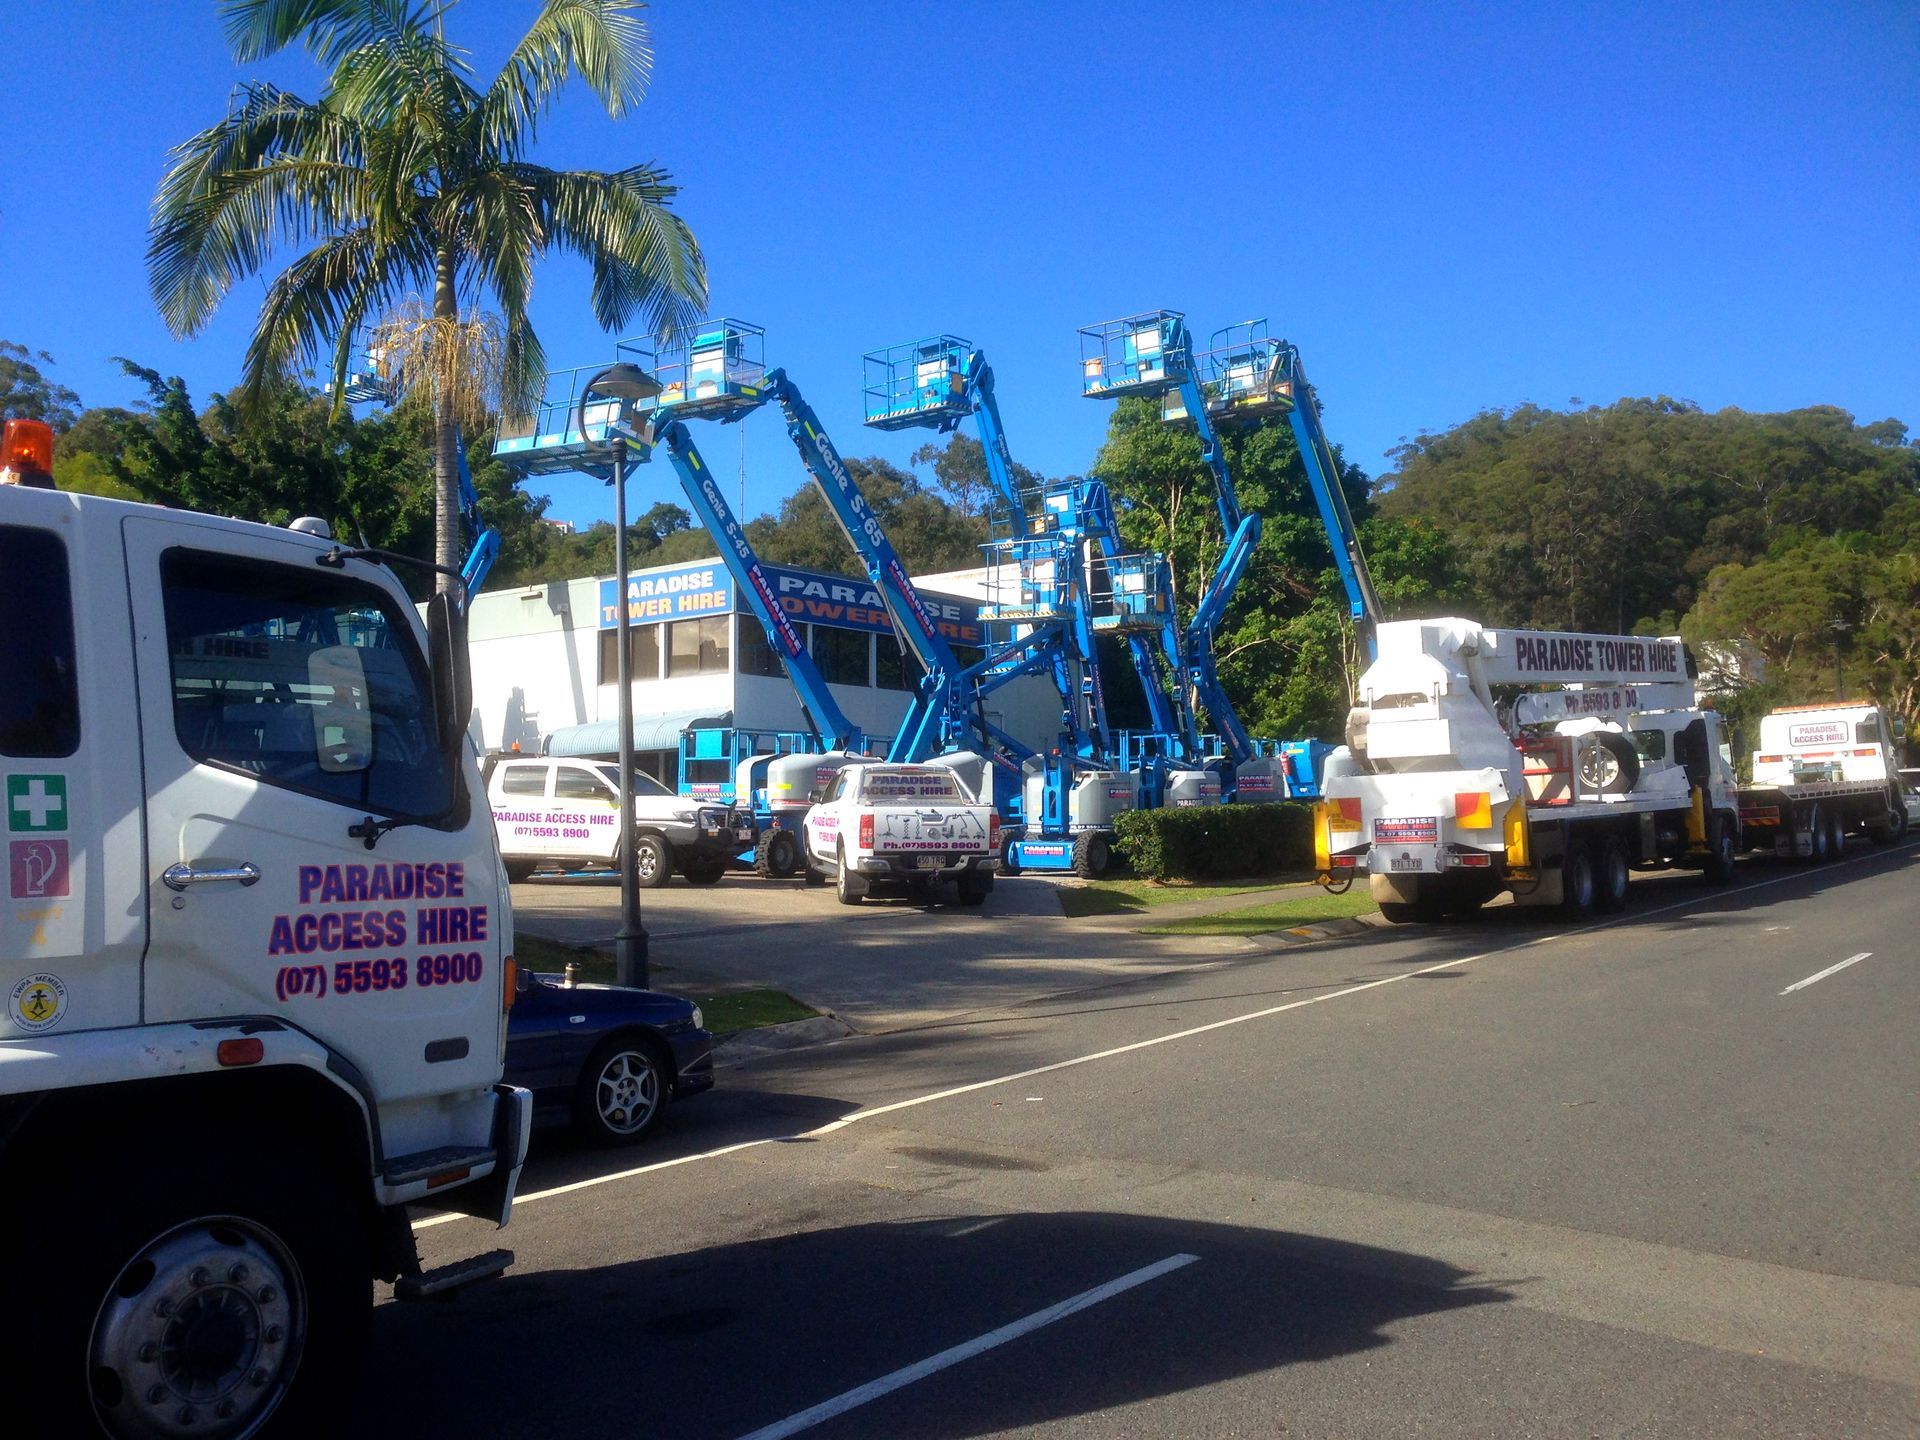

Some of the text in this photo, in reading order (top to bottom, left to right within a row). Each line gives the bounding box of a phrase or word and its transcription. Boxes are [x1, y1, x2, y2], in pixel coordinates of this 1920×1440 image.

[816, 432, 885, 547] Genie S-65
[703, 479, 750, 559] Genie S-45
[1108, 520, 1120, 549] Genie
[628, 570, 714, 599] ARADISE
[678, 590, 726, 612] HIRE
[752, 564, 802, 652] PARADISE
[779, 596, 893, 627] OWER
[1515, 637, 1678, 673] PARADISE TOWER HIRE
[1794, 732, 1845, 744] ACCESS HIRE
[1800, 725, 1838, 735] PARADISE
[864, 786, 953, 796] ACCESS HIRE
[872, 776, 941, 785] PARADISE
[492, 811, 615, 826] PARADISE ACCESS HIRE
[1375, 817, 1435, 825] PARADISE
[562, 828, 590, 839] 8900
[298, 861, 465, 905] PARADISE
[267, 904, 489, 957] ACCESS HIRE
[13, 975, 65, 999] EWPA MEMBER
[275, 951, 483, 1003] (07) 5593 8900
